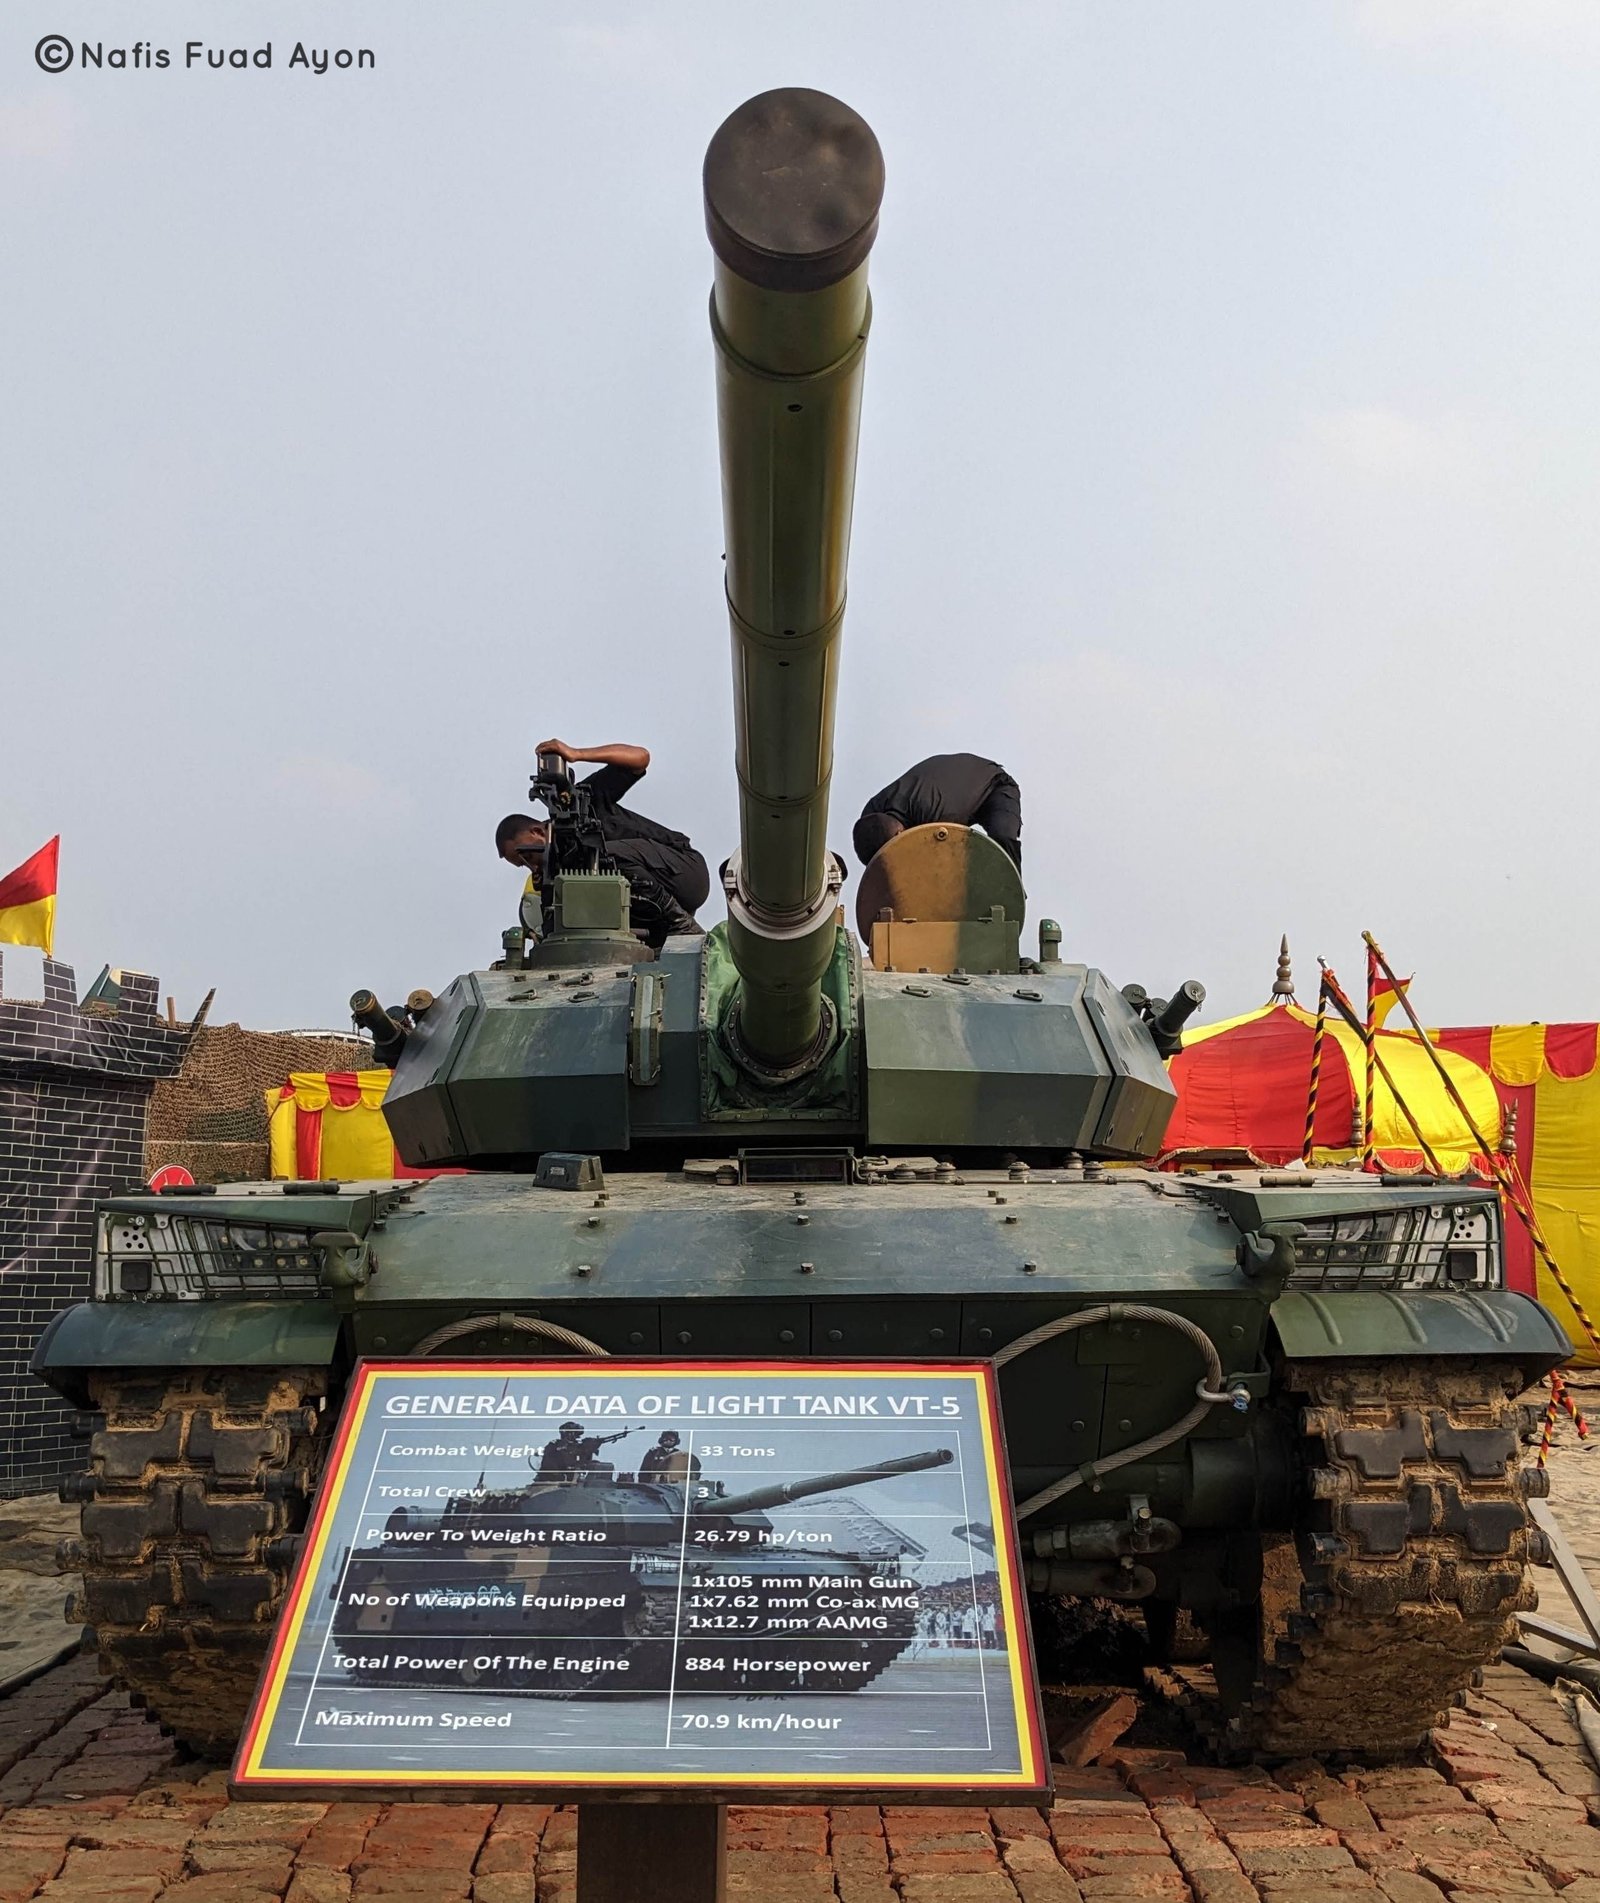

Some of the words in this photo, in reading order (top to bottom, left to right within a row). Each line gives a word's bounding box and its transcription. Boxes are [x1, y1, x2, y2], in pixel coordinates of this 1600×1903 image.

[385, 1395, 539, 1415] GENERAL
[545, 1395, 628, 1415] DATA
[637, 1395, 680, 1414] OF
[691, 1396, 786, 1415] LIGHT
[793, 1396, 880, 1415] TANK
[887, 1397, 960, 1415] VT-5
[389, 1445, 466, 1456] Combat
[473, 1445, 545, 1459] Weight
[700, 1446, 723, 1456] 33
[729, 1446, 776, 1457] Tons
[379, 1486, 429, 1497] Total
[434, 1486, 487, 1497] Crew
[697, 1487, 709, 1498] 3
[366, 1528, 434, 1541] Power
[440, 1530, 465, 1541] To
[470, 1530, 546, 1545] Weight
[551, 1529, 607, 1541] Ratio
[694, 1530, 750, 1542] 26.79
[758, 1529, 833, 1546] hp/ton
[691, 1575, 753, 1588] 1x105
[762, 1578, 801, 1588] mm
[808, 1576, 863, 1589] Main
[869, 1576, 913, 1589] Gun
[348, 1593, 380, 1606] No
[385, 1593, 411, 1607] of
[415, 1593, 517, 1609] Weapons
[521, 1594, 626, 1608] Equipped
[690, 1596, 759, 1609] 1x7.62
[767, 1599, 808, 1609] mm
[816, 1596, 876, 1609] Co-ax
[881, 1596, 919, 1609] MG
[689, 1616, 758, 1629] 1x12.7
[766, 1619, 808, 1629] mm
[816, 1617, 888, 1630] AAMG
[331, 1655, 389, 1669] Total
[393, 1656, 468, 1671] Power
[472, 1656, 503, 1671] Of
[507, 1657, 547, 1671] The
[552, 1658, 630, 1674] Engine
[685, 1658, 726, 1672] 884
[732, 1658, 872, 1674] Horsepower
[314, 1712, 433, 1727] Maximum
[438, 1713, 512, 1730] Speed
[681, 1714, 730, 1730] 70.9
[736, 1714, 842, 1731] km/hour
